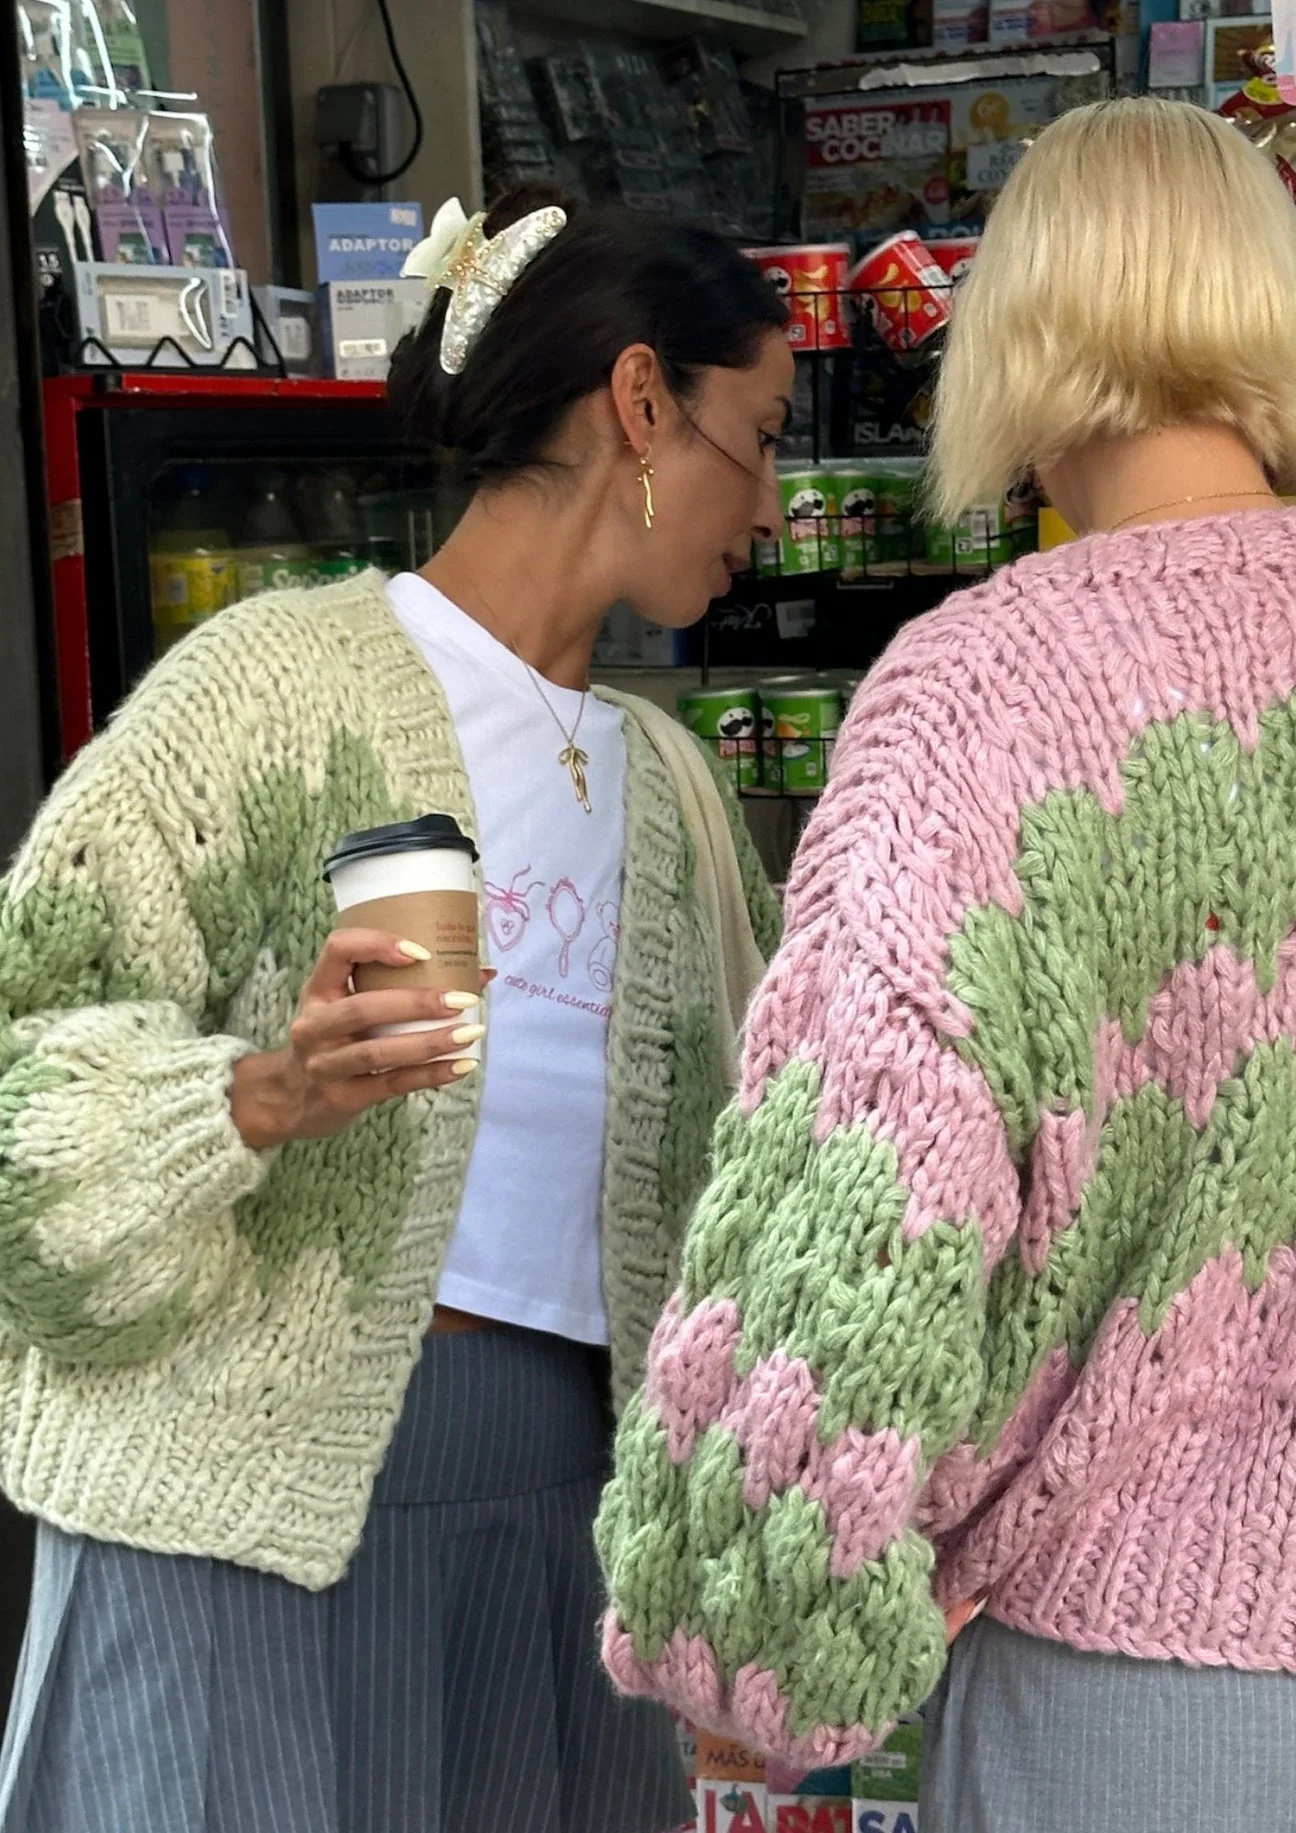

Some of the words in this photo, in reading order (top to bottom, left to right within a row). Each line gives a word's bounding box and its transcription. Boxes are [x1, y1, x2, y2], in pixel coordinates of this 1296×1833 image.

[806, 110, 896, 142] SABER
[821, 130, 948, 163] COCINAR
[329, 238, 413, 252] ADAPTOR
[336, 288, 394, 299] ADAPTOR
[528, 977, 554, 999] girl
